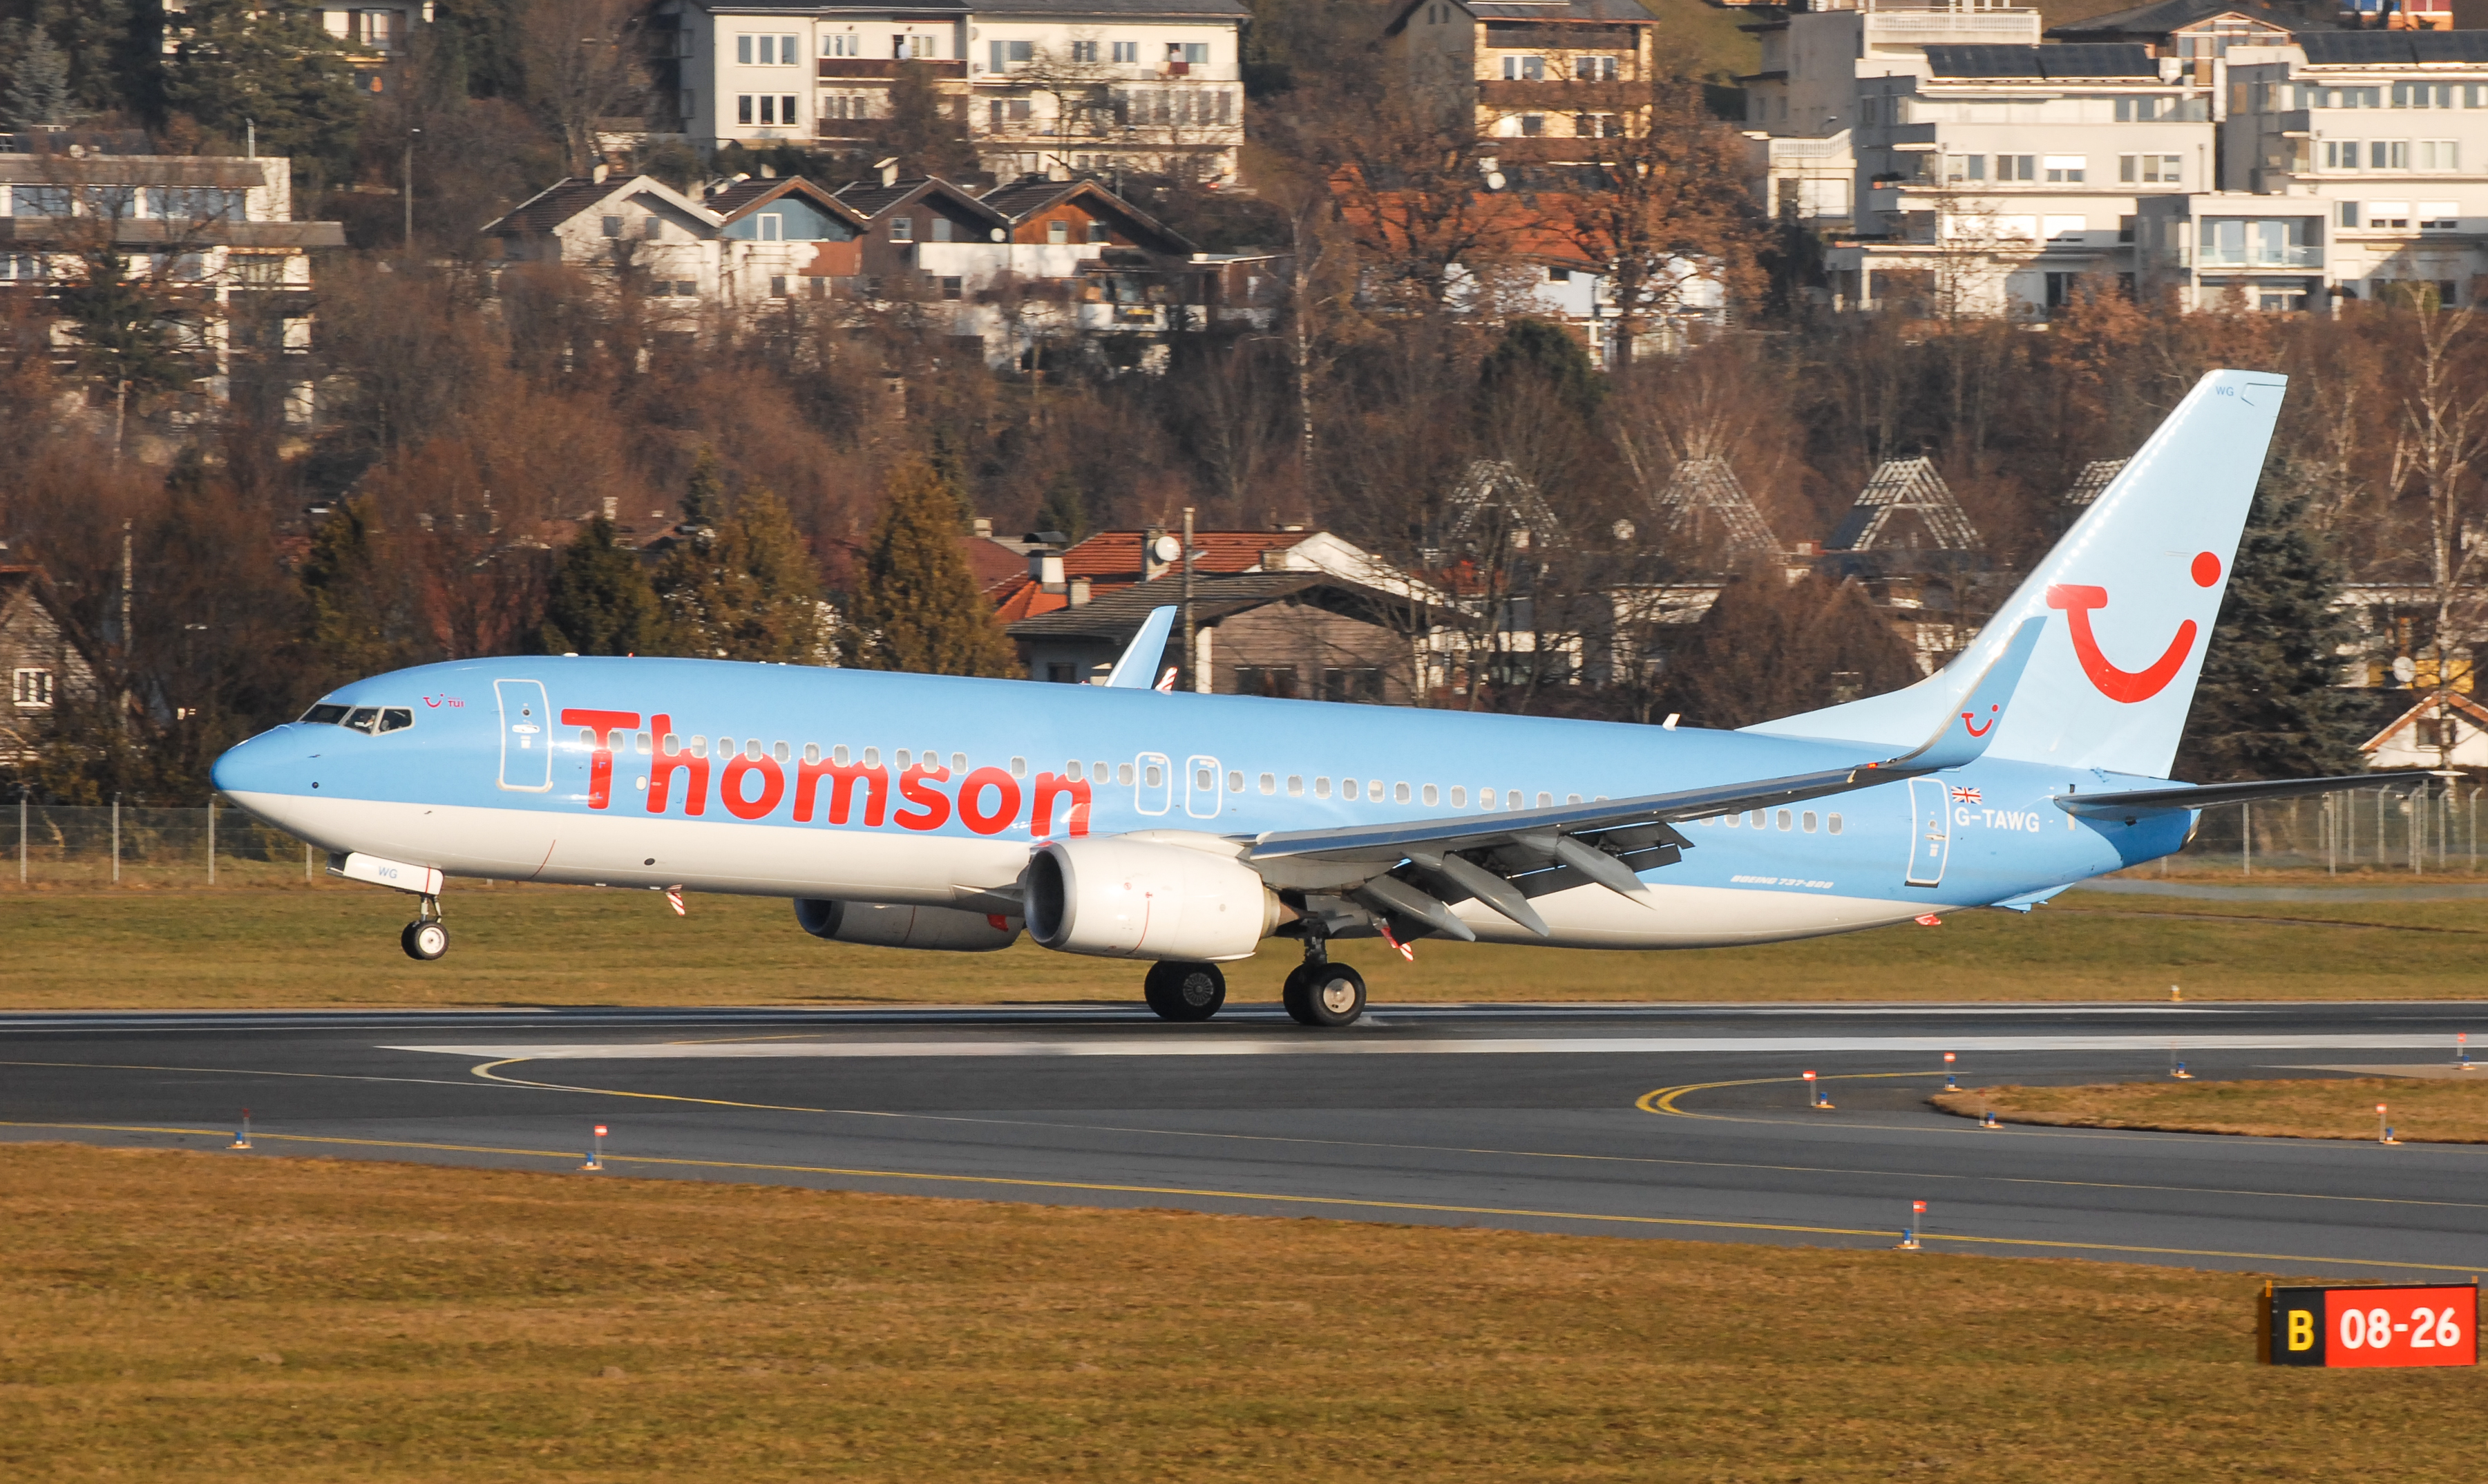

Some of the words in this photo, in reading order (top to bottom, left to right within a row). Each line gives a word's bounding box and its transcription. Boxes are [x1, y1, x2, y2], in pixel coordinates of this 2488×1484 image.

[2215, 386, 2234, 397] WG
[448, 700, 464, 708] TUI
[560, 707, 1093, 839] Thomson
[1954, 806, 2040, 833] G-TAWG
[378, 866, 398, 879] WG
[1730, 875, 1778, 885] BOEING
[2287, 1309, 2315, 1351] B
[2339, 1306, 2462, 1350] 08-26
